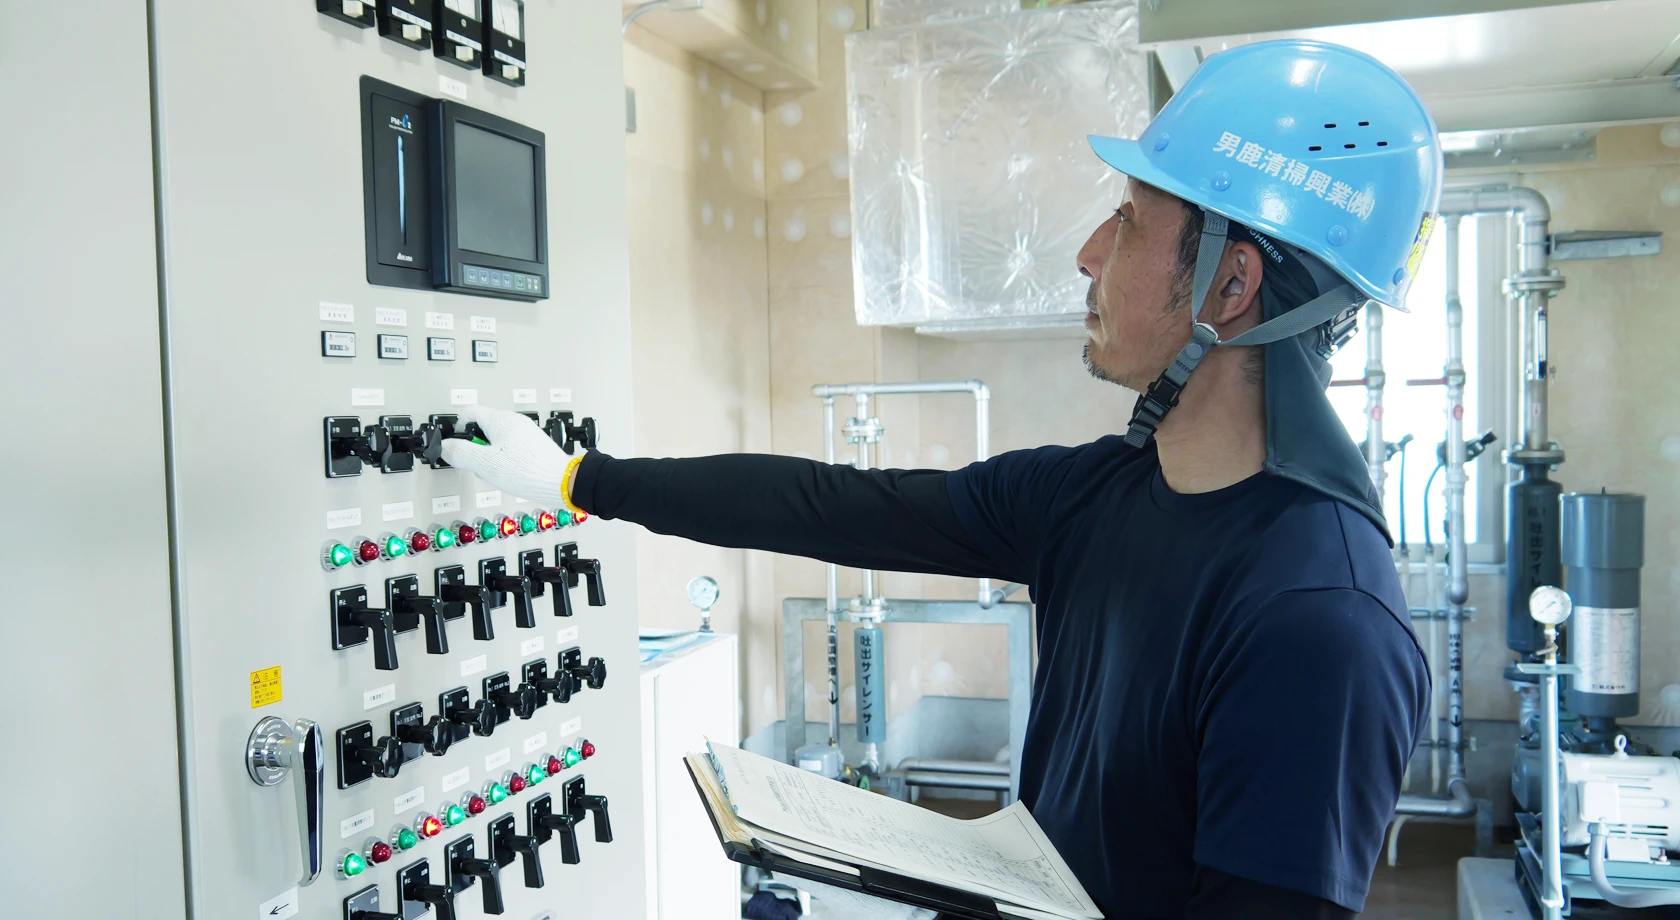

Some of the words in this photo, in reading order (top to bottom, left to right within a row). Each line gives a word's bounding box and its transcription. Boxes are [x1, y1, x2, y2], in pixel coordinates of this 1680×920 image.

[859, 635, 873, 736] 吐出サイレンサー
